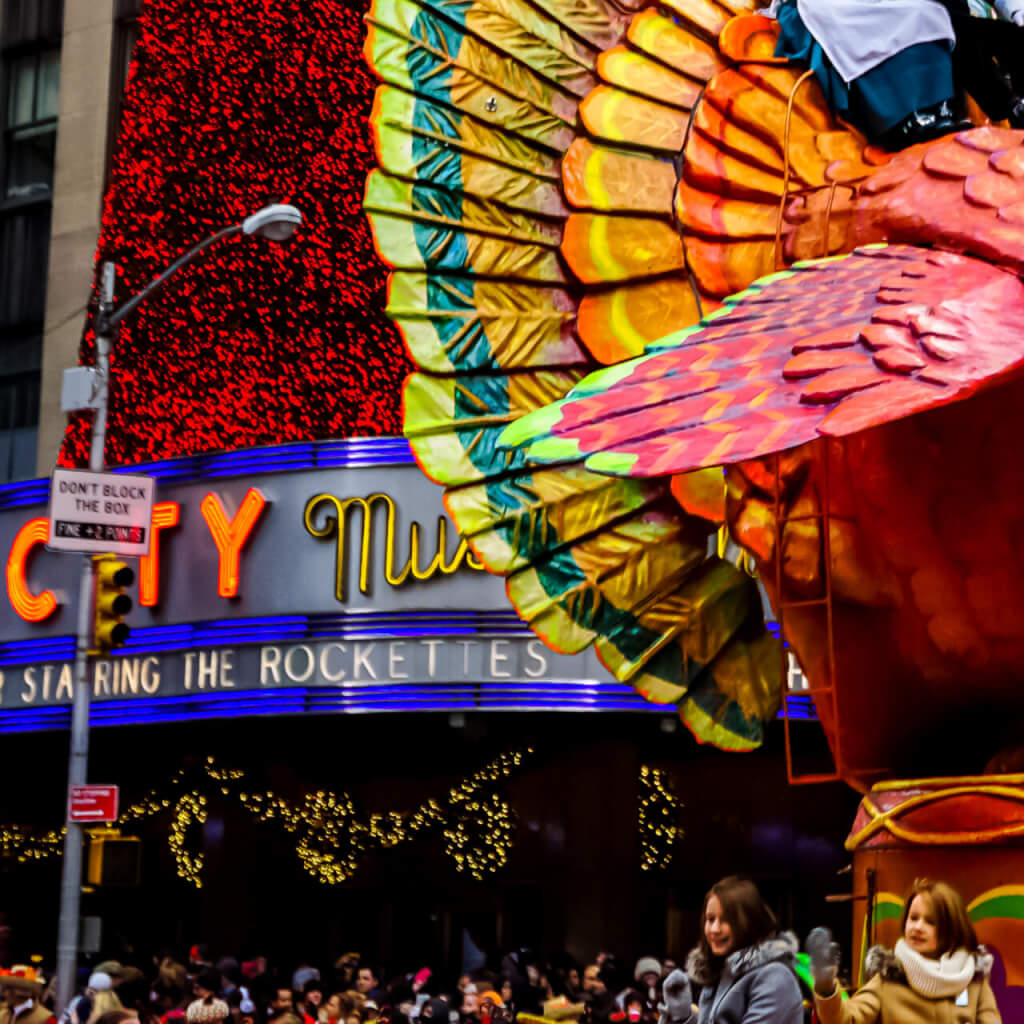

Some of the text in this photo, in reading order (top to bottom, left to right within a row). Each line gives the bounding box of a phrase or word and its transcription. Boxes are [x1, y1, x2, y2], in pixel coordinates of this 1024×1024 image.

[59, 480, 146, 499] DON'T BLOCK
[75, 498, 130, 515] THE BOX
[58, 522, 80, 536] FINE
[6, 487, 266, 622] CTY
[21, 656, 160, 703] STARING
[184, 649, 235, 689] THE
[260, 639, 548, 685] ROCKETTES
